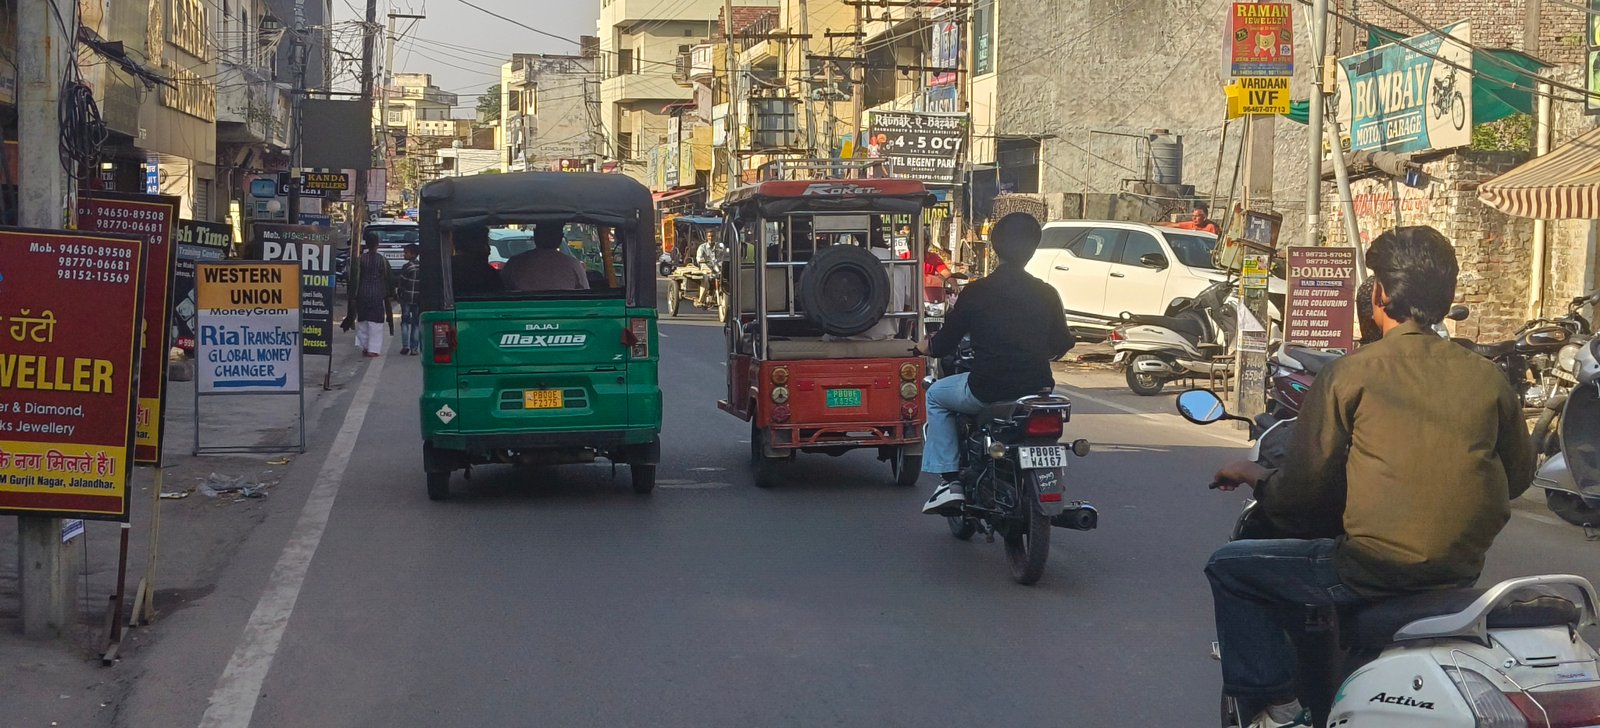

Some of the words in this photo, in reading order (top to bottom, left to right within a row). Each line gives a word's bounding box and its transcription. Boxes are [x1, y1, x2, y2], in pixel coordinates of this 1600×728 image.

[1237, 5, 1289, 17] RAMAN
[1240, 78, 1287, 89] VARDAAN
[1248, 91, 1279, 105] IVF
[1355, 62, 1427, 121] BOMBAY
[1387, 115, 1422, 139] GARAGE
[895, 135, 905, 148] 4
[918, 136, 926, 148] 5
[930, 137, 962, 150] OCT
[906, 158, 936, 168] REGENT
[937, 159, 956, 168] PARK
[308, 174, 345, 182] KANDA
[196, 226, 229, 247] Time
[30, 242, 56, 253] Mob.
[263, 242, 331, 271] PARI
[58, 257, 130, 271] 98770-06681
[57, 270, 130, 284] 98152-15569
[204, 268, 282, 283] WESTERN
[1291, 267, 1354, 278] BOMBAY
[303, 275, 330, 286] TION
[230, 288, 282, 305] UNION
[201, 325, 240, 346] Ria
[499, 333, 587, 346] Maxima
[208, 349, 255, 362] GLOBAL
[257, 348, 292, 361] MONEY
[214, 364, 275, 377] CHANGER
[12, 402, 20, 413] &
[25, 402, 85, 417] Diamond,
[16, 421, 75, 436] Jewellery
[1029, 447, 1061, 457] PB08E
[1030, 457, 1062, 467] W4167
[10, 475, 34, 487] Gurjit
[37, 476, 66, 488] Nagar,
[69, 477, 116, 489] Jalandhar.
[1369, 692, 1435, 710] Activa
